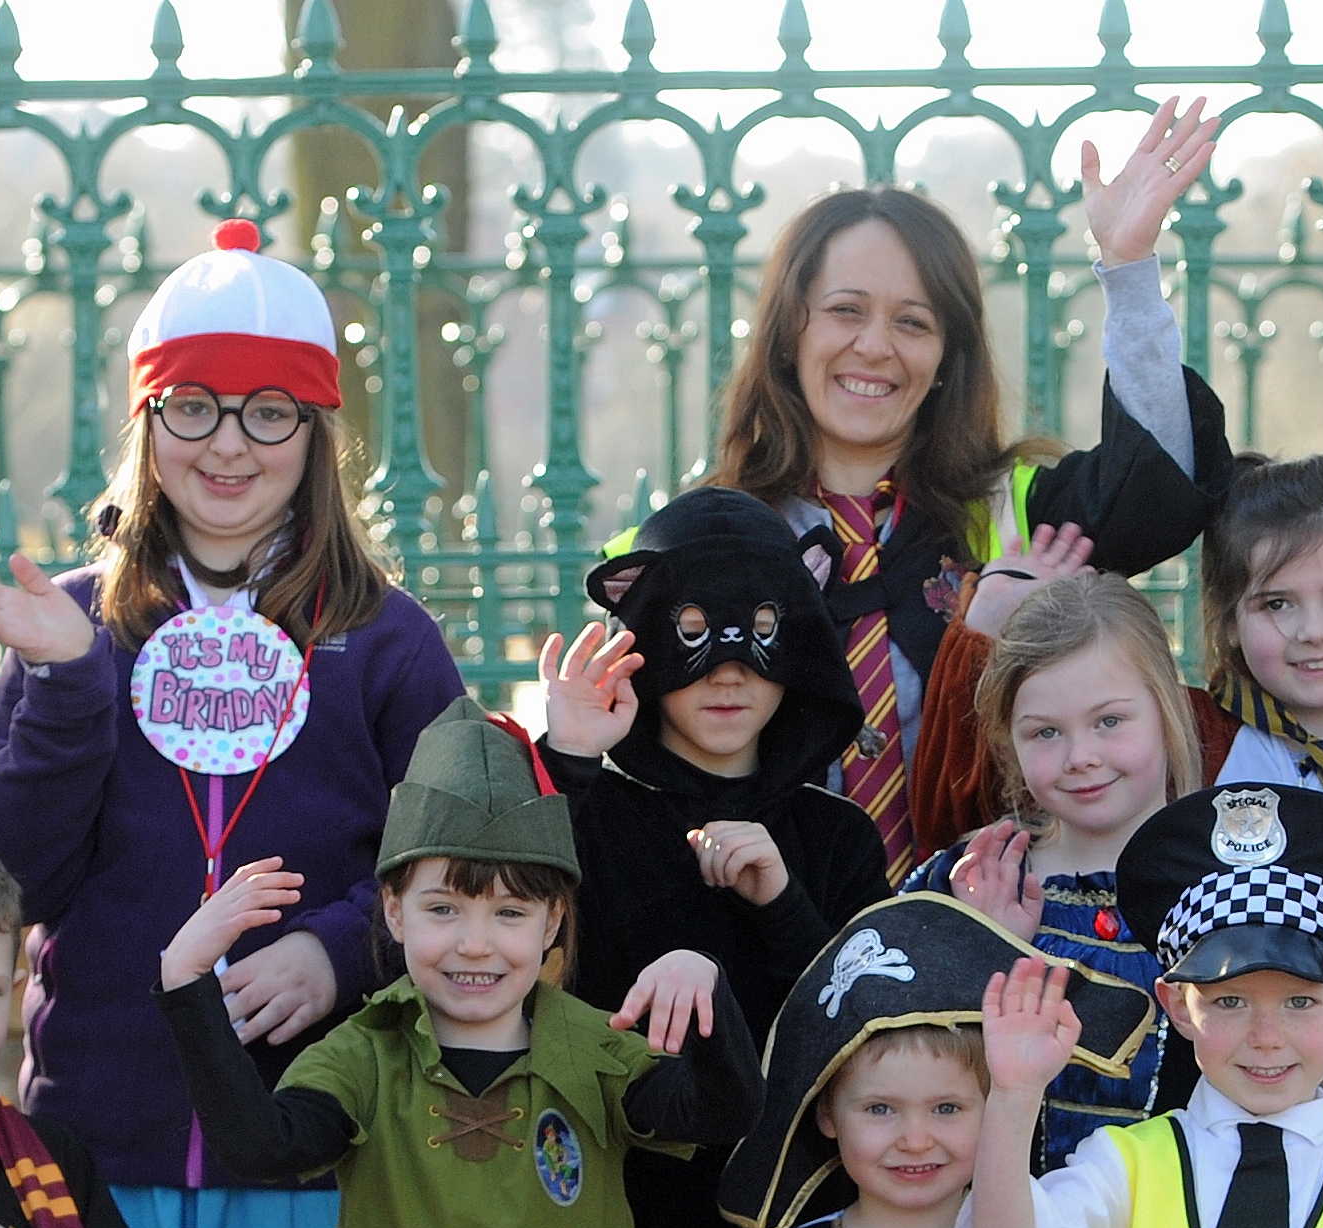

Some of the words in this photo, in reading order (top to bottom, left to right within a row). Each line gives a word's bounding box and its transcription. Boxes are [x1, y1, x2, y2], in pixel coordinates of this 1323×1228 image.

[162, 632, 222, 669] it's
[228, 632, 281, 681] My
[1226, 797, 1269, 809] SPECIAL
[1225, 838, 1274, 853] POLICE
